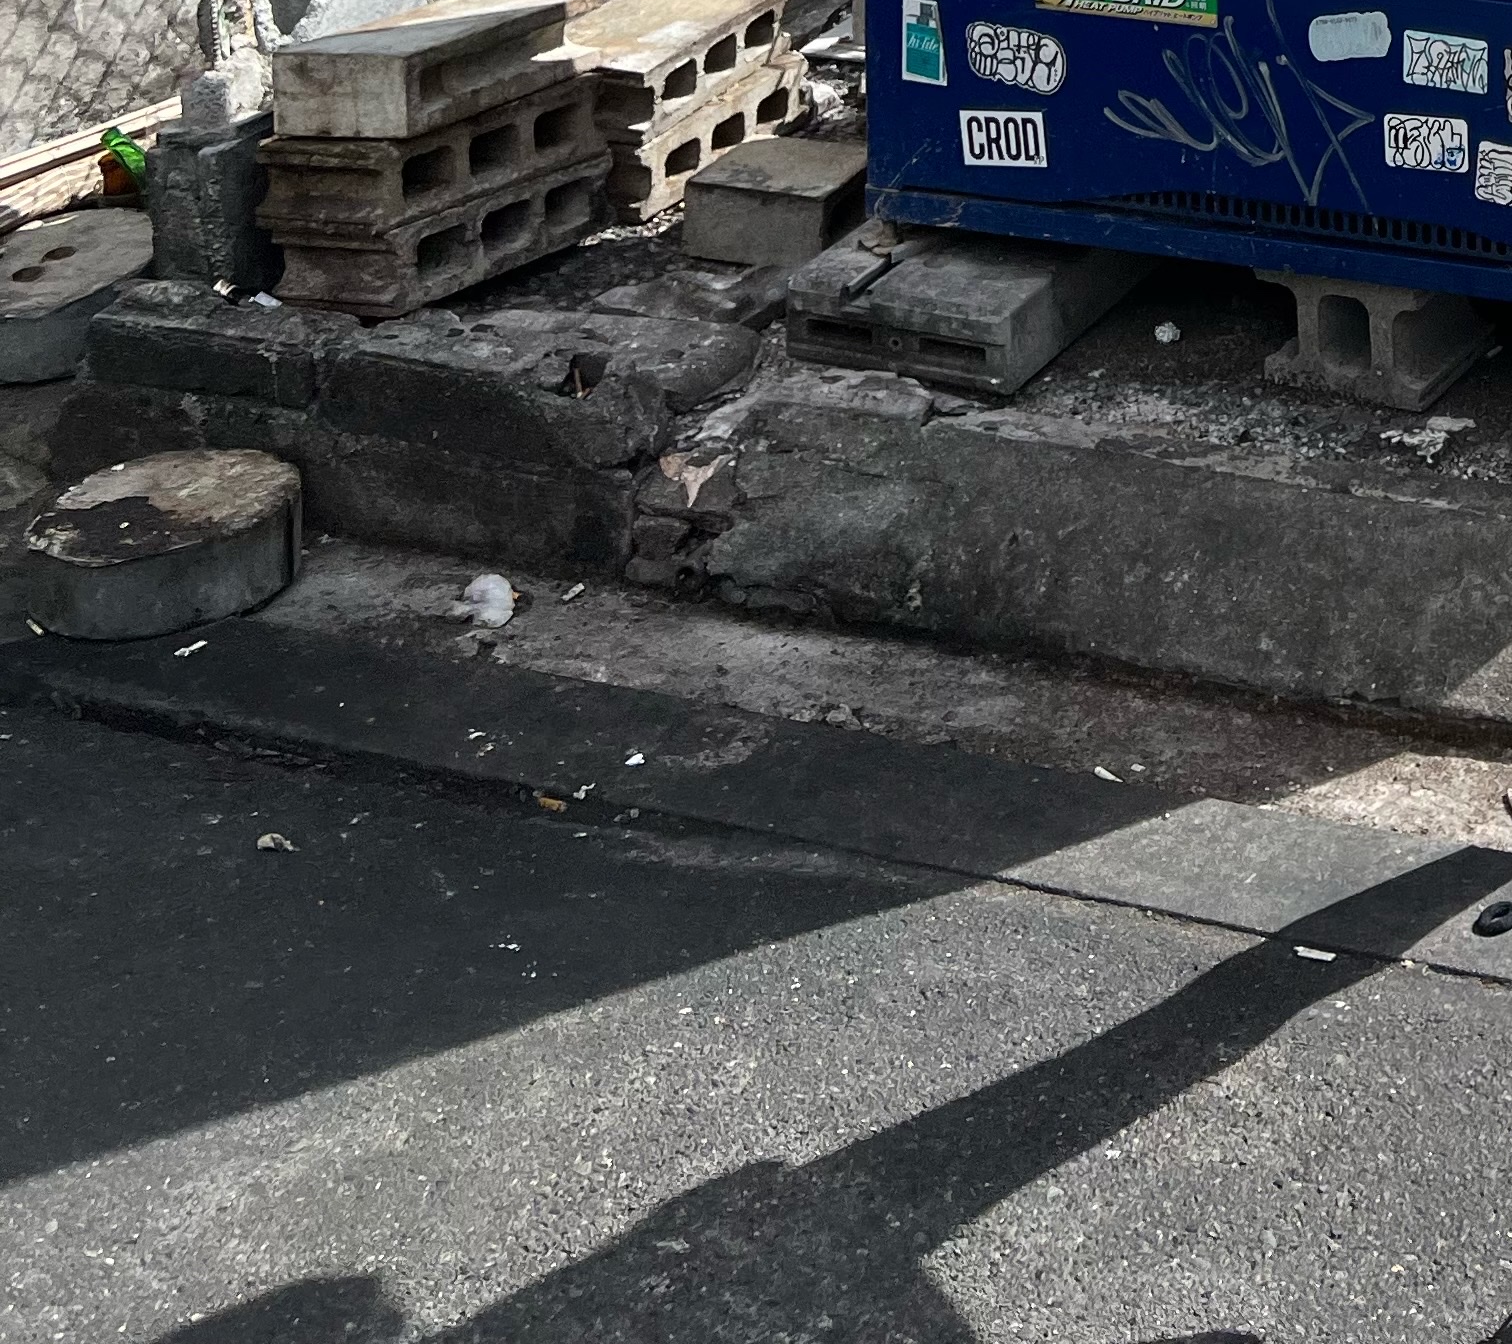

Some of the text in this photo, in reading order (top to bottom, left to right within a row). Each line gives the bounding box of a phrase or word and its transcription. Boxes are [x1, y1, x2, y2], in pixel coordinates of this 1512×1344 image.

[1074, 0, 1143, 16] HEAT PUMP
[966, 115, 1041, 161] CROD
